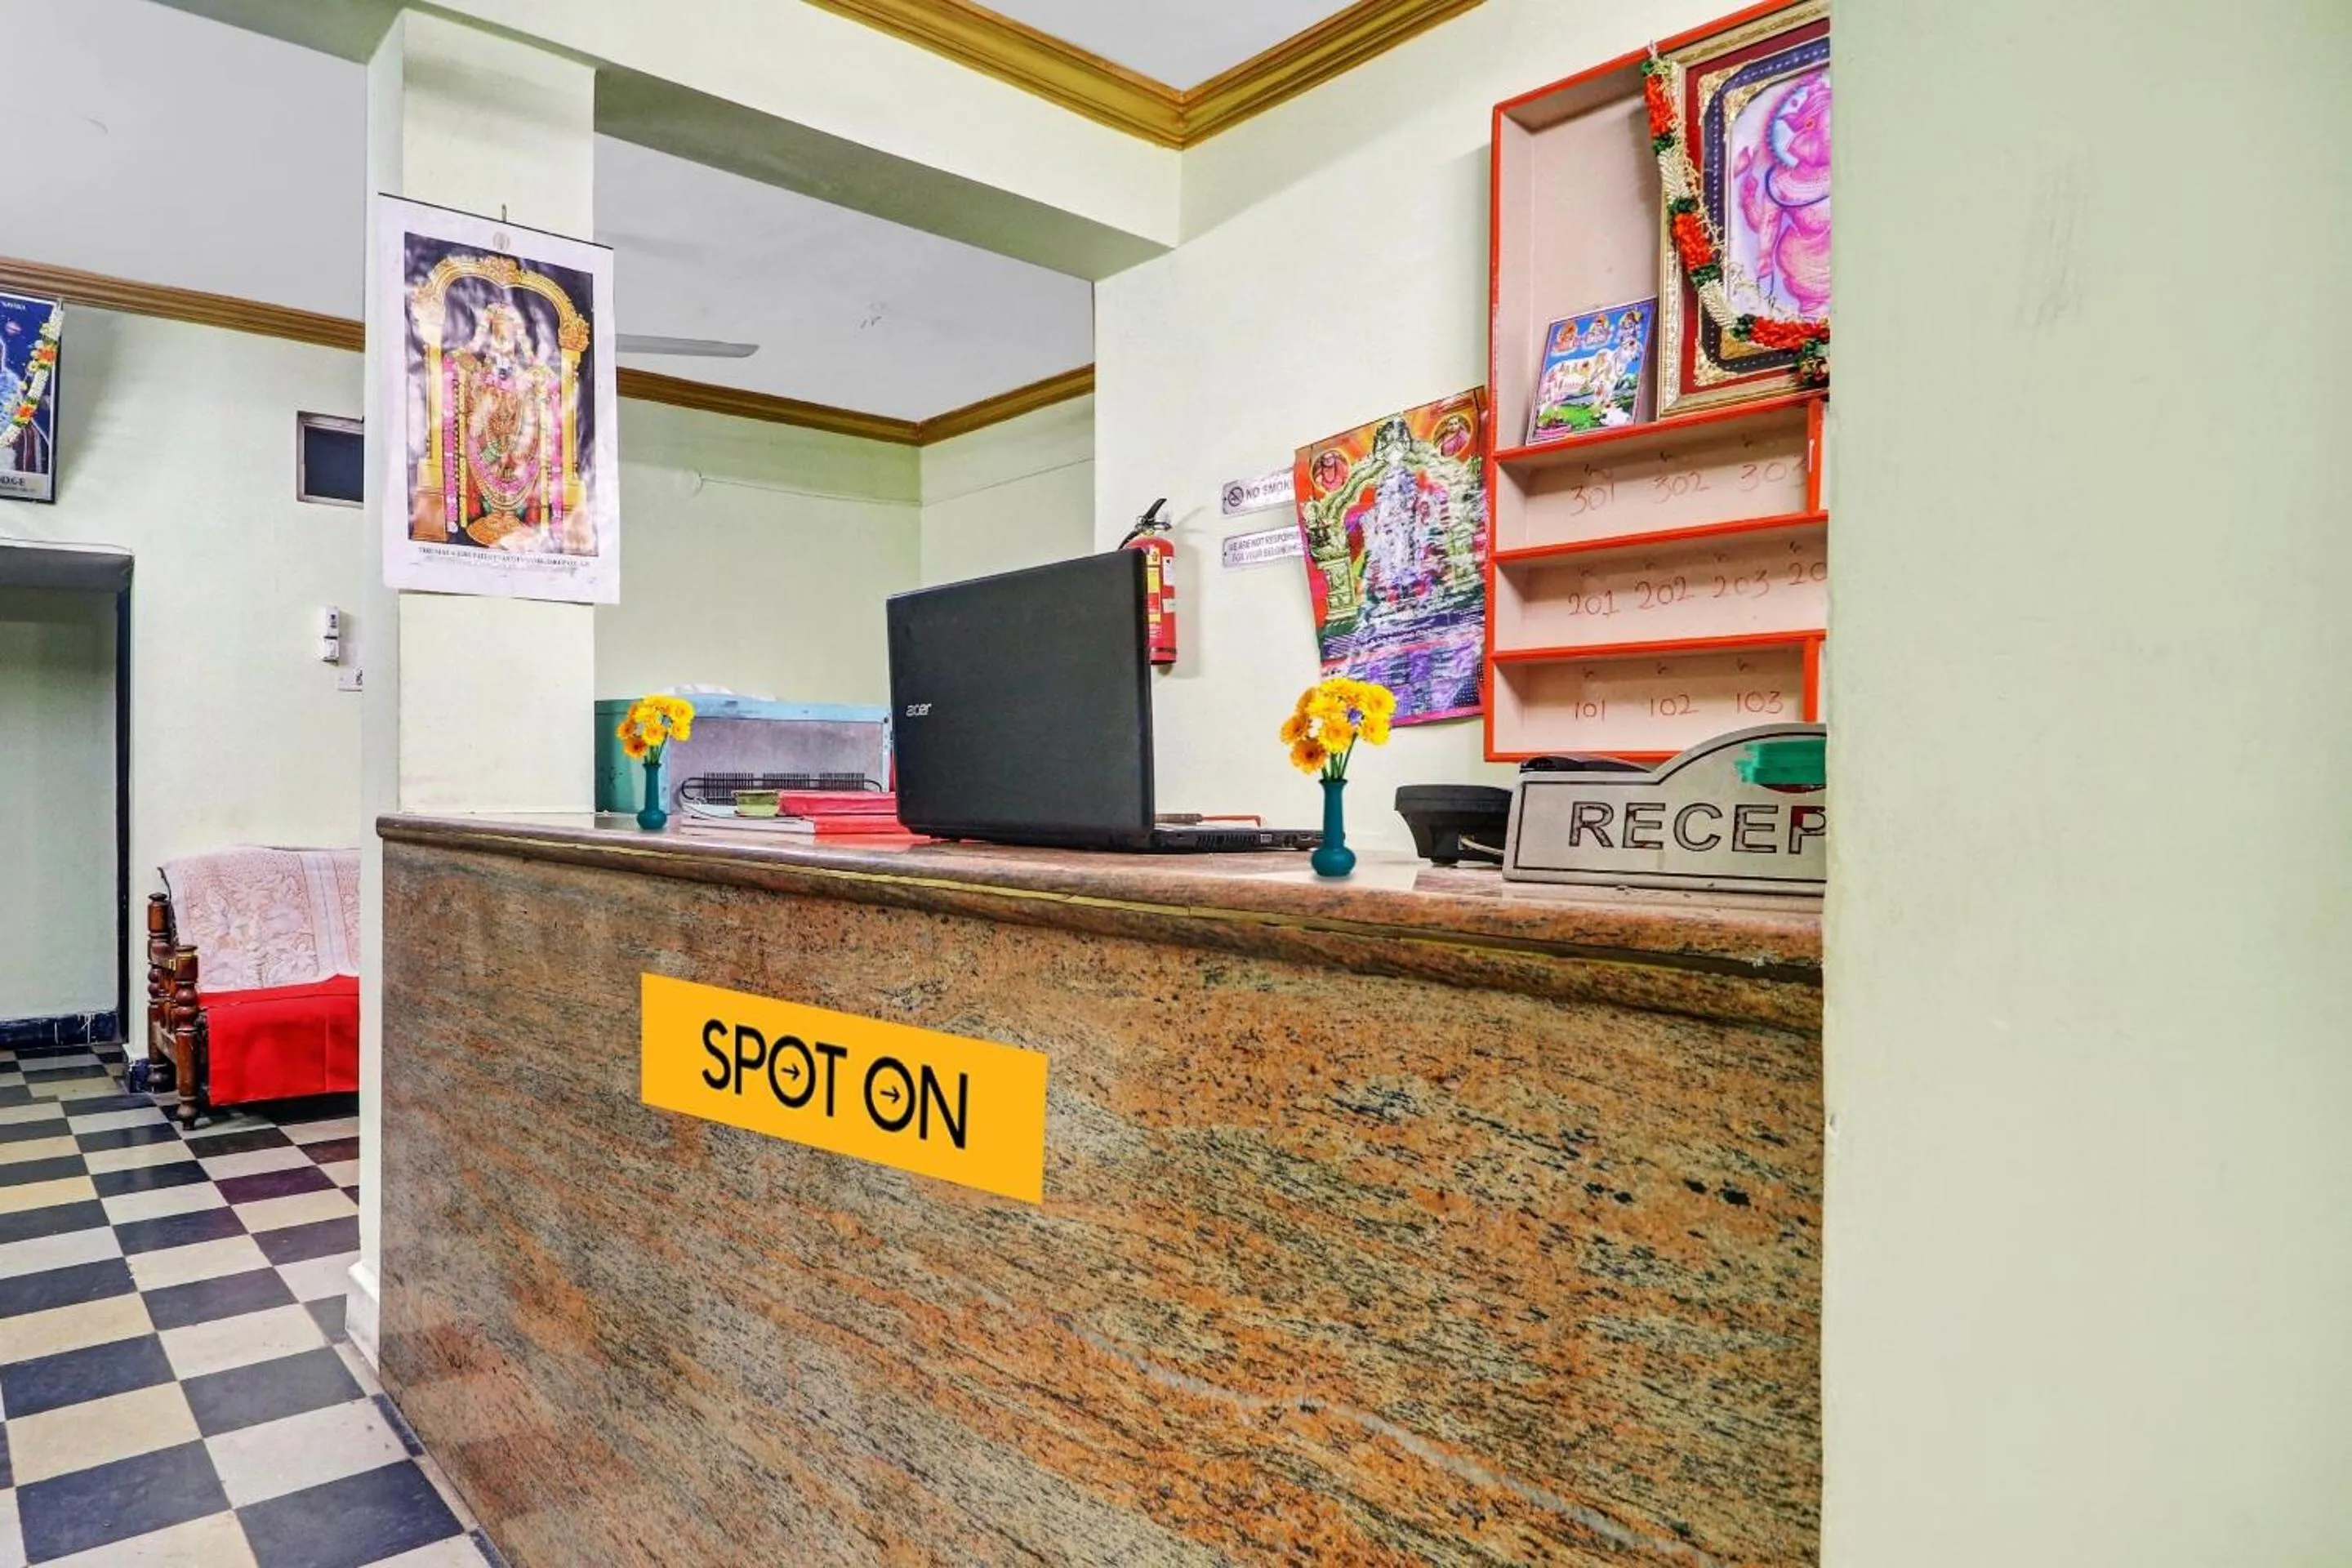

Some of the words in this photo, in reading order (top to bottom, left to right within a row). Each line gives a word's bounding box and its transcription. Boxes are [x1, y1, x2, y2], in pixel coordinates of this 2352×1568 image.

[1246, 486, 1261, 501] NO
[1570, 482, 1615, 517] 301
[1651, 470, 1711, 505] 302
[1568, 590, 1620, 616] 201
[1634, 576, 1694, 610] 202
[1711, 569, 1770, 599] 203
[906, 703, 932, 717] acer
[1575, 700, 1606, 722] 101
[1650, 694, 1699, 717] 102
[1736, 691, 1784, 715] 103
[1569, 801, 1827, 854] RECEP
[702, 1018, 847, 1117] SPOT
[864, 1057, 969, 1150] ON
